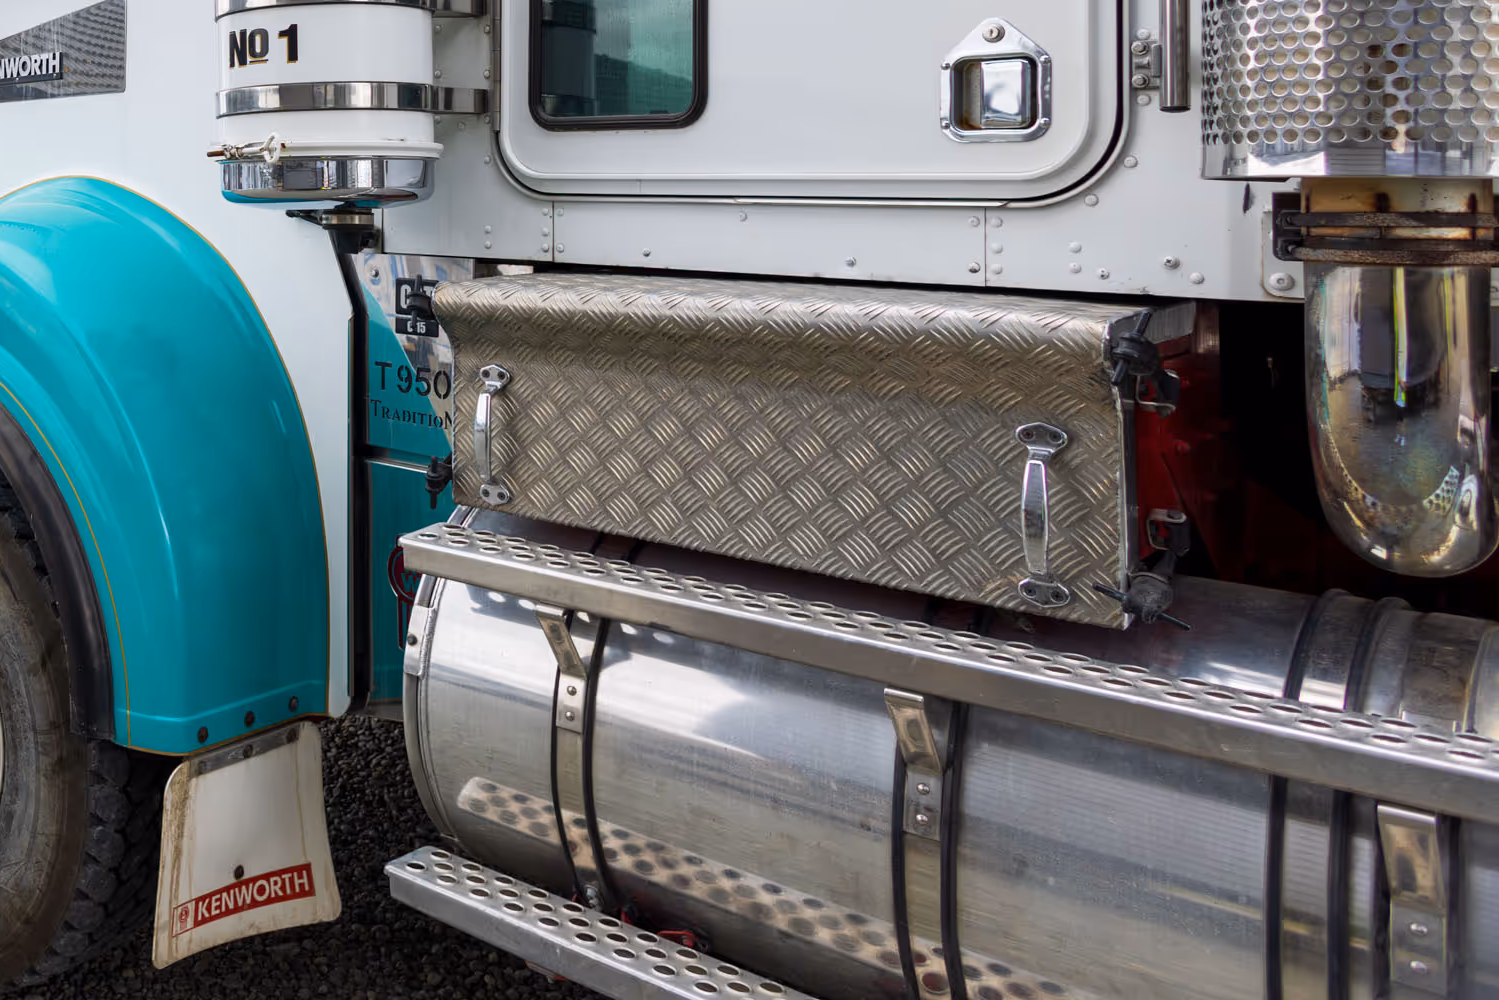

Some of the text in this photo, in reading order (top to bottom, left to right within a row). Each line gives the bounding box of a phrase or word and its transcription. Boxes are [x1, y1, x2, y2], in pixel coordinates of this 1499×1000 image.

[278, 23, 299, 64] 1
[374, 360, 452, 400] T950
[197, 869, 309, 922] KENWORTH
